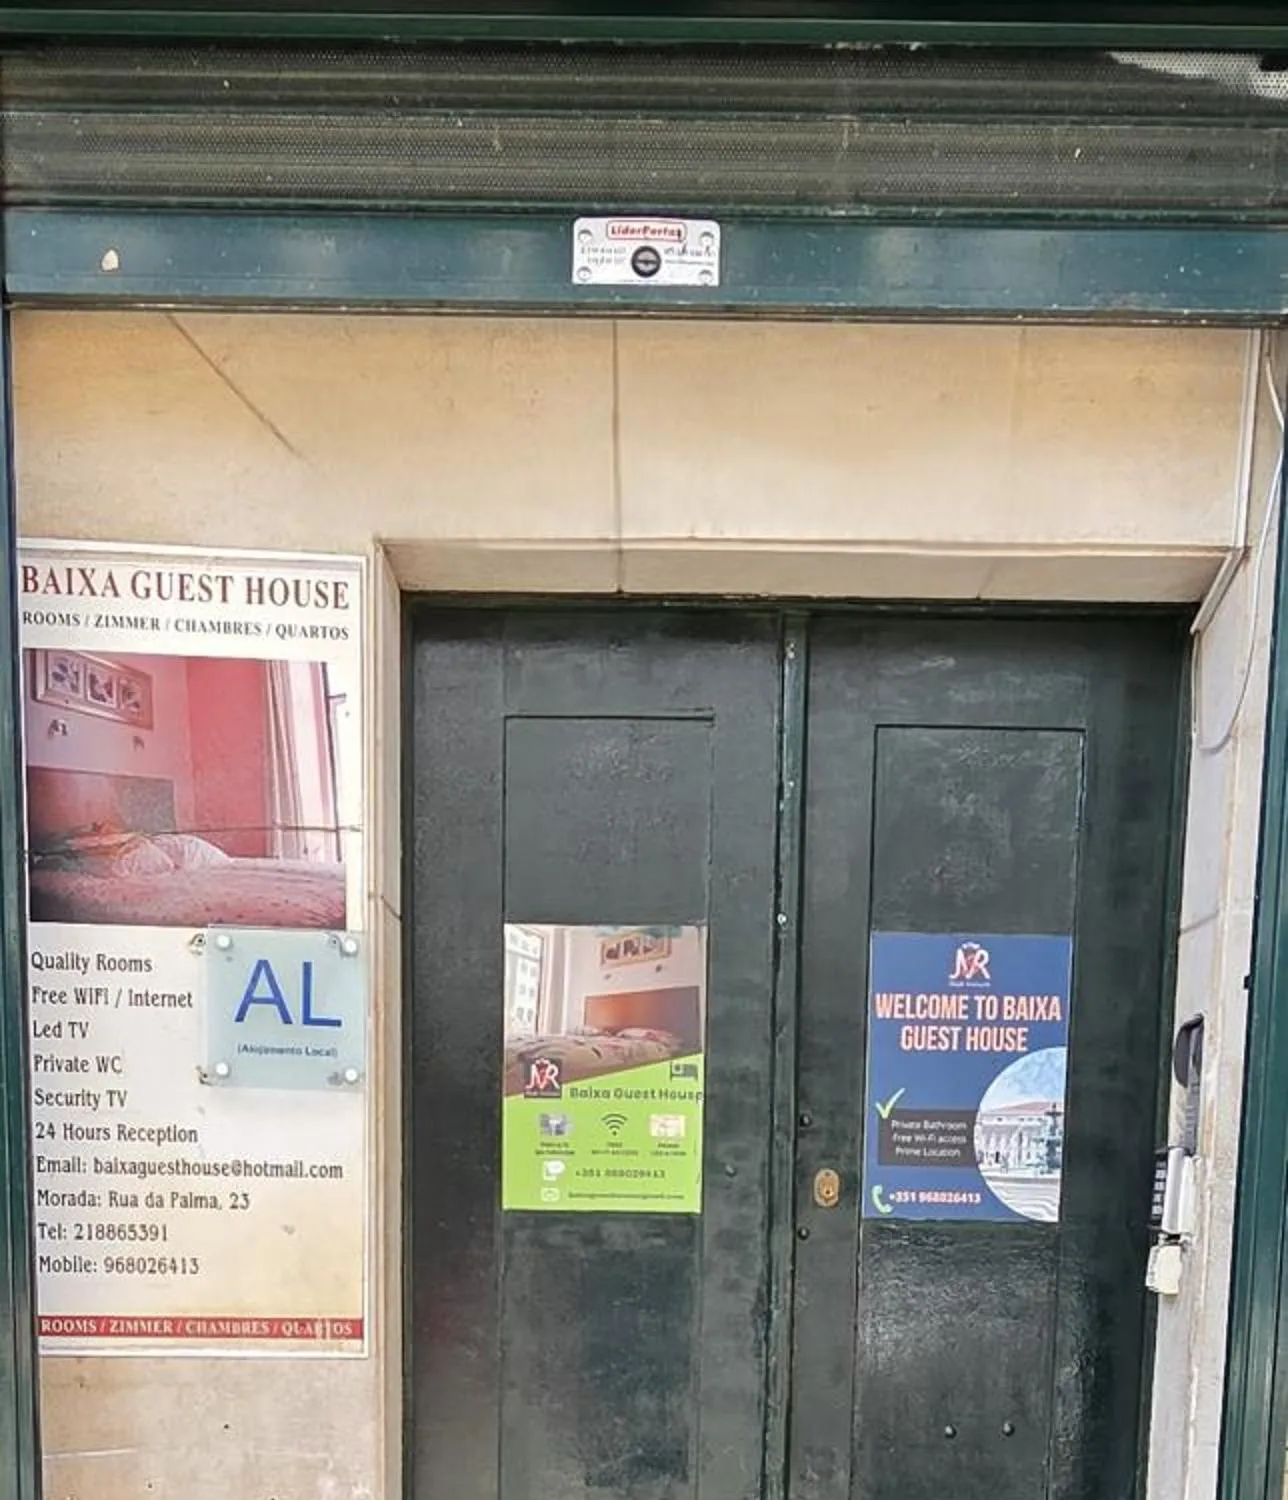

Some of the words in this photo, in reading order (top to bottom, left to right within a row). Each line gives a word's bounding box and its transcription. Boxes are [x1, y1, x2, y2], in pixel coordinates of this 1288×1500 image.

[21, 565, 123, 599] BAIXA
[130, 569, 235, 604] GUEST
[246, 576, 350, 610] HOUSE
[22, 611, 81, 628] ROOMS
[94, 614, 161, 632] ZIMMER
[174, 618, 262, 637] CHAMBRES
[275, 623, 349, 641] QUARTOS
[31, 951, 90, 976] Quality
[96, 954, 153, 973] Rooms
[32, 985, 67, 1005] Free
[128, 990, 194, 1009] Internet
[234, 959, 343, 1028] AL
[875, 993, 969, 1020] WELCOME
[974, 994, 998, 1021] TO
[1003, 995, 1062, 1021] BAIXA
[33, 1020, 62, 1039] Led
[68, 1021, 90, 1039] TV
[901, 1025, 963, 1051] GUEST
[966, 1026, 1028, 1052] HOUSE
[34, 1055, 90, 1073] Private
[96, 1055, 123, 1074] WC
[34, 1087, 101, 1111] Security
[106, 1089, 128, 1107] TV
[570, 1086, 610, 1101] Baixa
[613, 1087, 656, 1101] Guest
[35, 1122, 56, 1141] 24
[63, 1123, 111, 1142] Hours
[117, 1124, 199, 1147] Reception
[891, 1119, 921, 1130] Private
[923, 1120, 967, 1131] Bathroom
[895, 1147, 921, 1157] Prime
[923, 1147, 961, 1158] Location
[37, 1155, 87, 1174] Email:
[93, 1157, 344, 1179] baixaguesthouse@hotmail.com
[37, 1189, 102, 1208] Morada:
[108, 1191, 139, 1208] Rua
[145, 1191, 165, 1209] da
[170, 1192, 222, 1211] Palma,
[229, 1192, 250, 1210] 23
[38, 1223, 67, 1241] Tel:
[74, 1223, 168, 1242] 218865391
[39, 1256, 97, 1274] Mobile:
[104, 1256, 200, 1275] 968026413
[40, 1319, 97, 1334] ROOMS
[109, 1319, 173, 1334] ZIMMER
[185, 1320, 269, 1335] CHAMBRES
